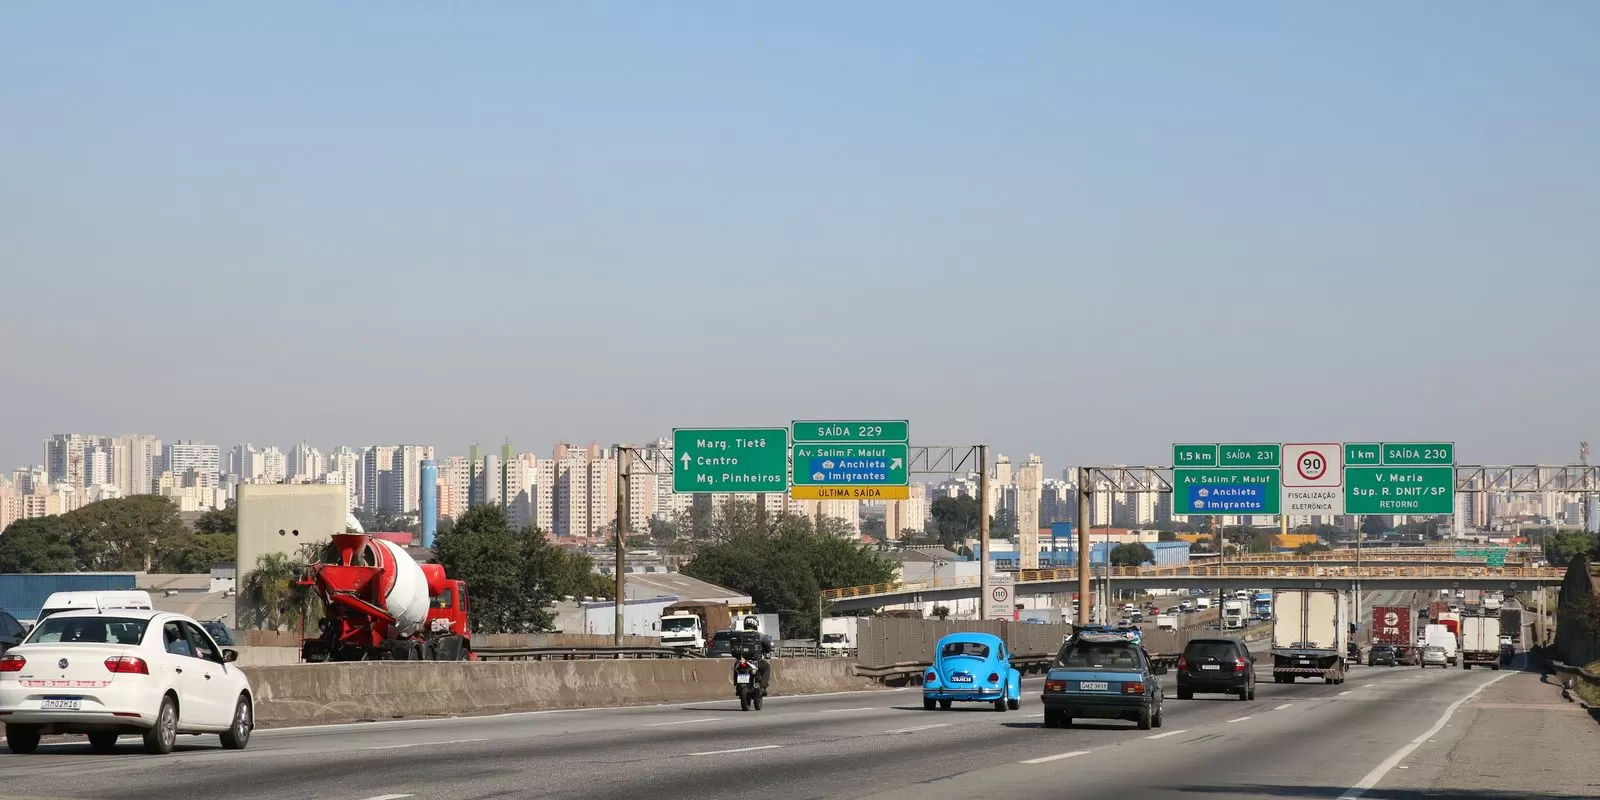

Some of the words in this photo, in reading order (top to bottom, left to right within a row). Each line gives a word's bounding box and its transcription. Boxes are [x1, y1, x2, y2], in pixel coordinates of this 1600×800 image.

[818, 424, 850, 436] SAÍDA
[858, 426, 882, 437] 229
[697, 439, 730, 450] Marg.
[736, 438, 766, 448] Tietê
[817, 448, 844, 457] Salim
[847, 448, 855, 456] F.
[858, 448, 885, 457] Maluf
[1195, 452, 1211, 460] km
[1226, 449, 1251, 459] SAÍDA
[1257, 451, 1273, 460] 231
[1351, 450, 1354, 459] 1
[1358, 450, 1374, 458] km
[1389, 448, 1420, 458] SAÍDA
[1424, 449, 1447, 459] 230
[697, 456, 738, 465] Centro
[839, 460, 885, 468] Anchieta
[1303, 458, 1321, 470] 90
[697, 474, 718, 485] Mg.
[722, 473, 781, 482] Pinheiros
[829, 472, 885, 482] Imigrantes
[1375, 473, 1385, 482] V.
[1390, 474, 1423, 482] Maria
[818, 486, 850, 497] ÚLTIMA
[854, 486, 881, 497] SAÍDA
[1288, 492, 1336, 500] FISCALIZAÇÃO
[1353, 487, 1377, 497] Sup.
[1382, 487, 1391, 495] R.
[1396, 487, 1446, 496] DNIT/SP
[1208, 501, 1260, 510] Imigrantes
